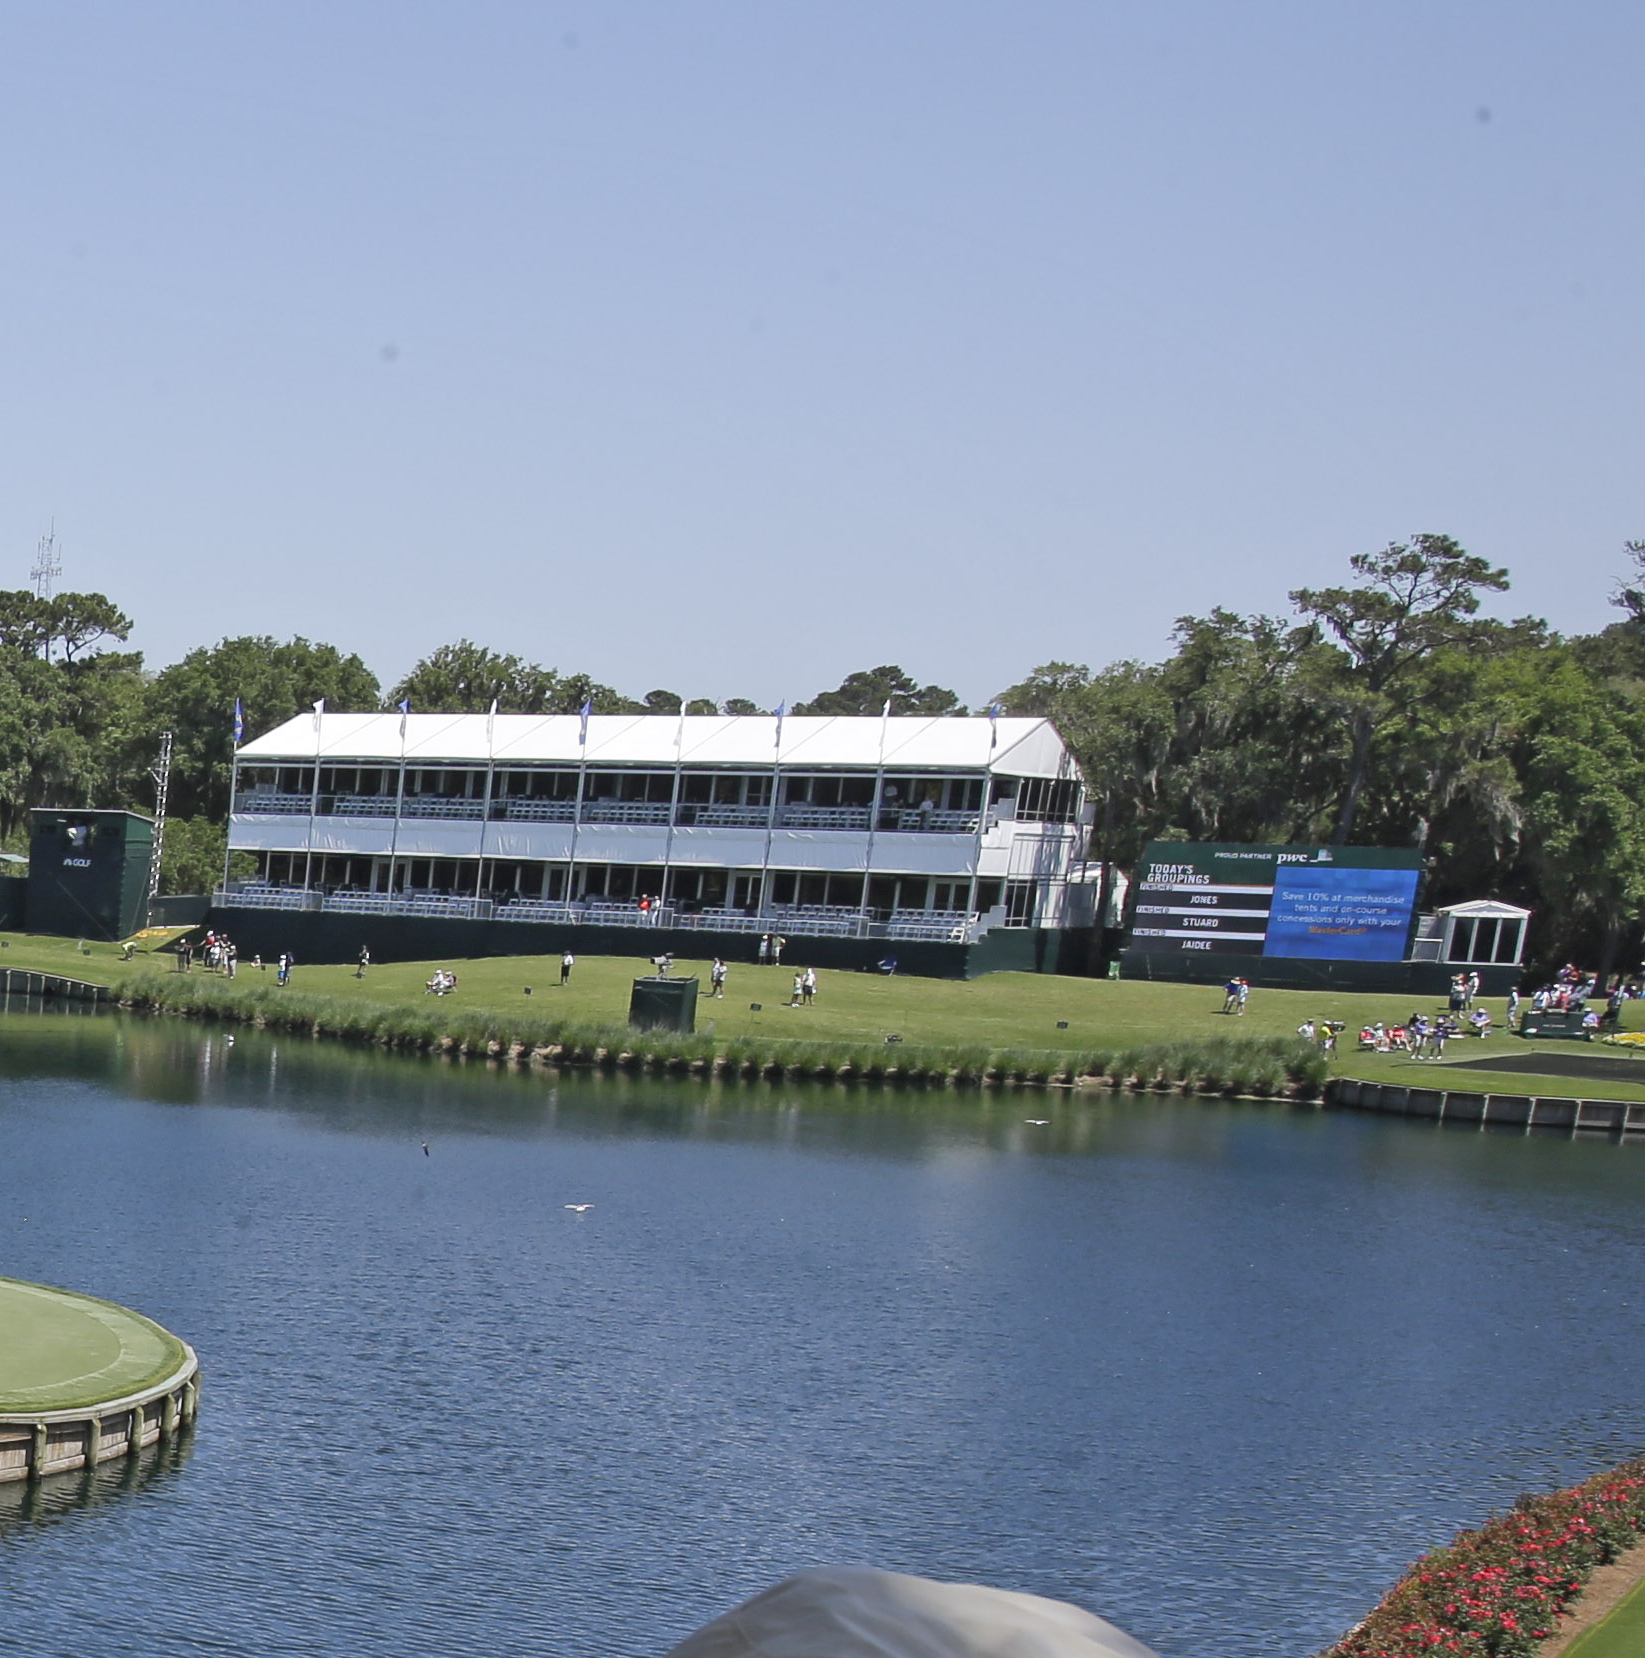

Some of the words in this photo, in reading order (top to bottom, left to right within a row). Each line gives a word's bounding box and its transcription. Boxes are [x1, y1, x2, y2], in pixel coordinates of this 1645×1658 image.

[1276, 853, 1308, 865] pwc
[1149, 863, 1194, 874] TODAY'S
[1147, 873, 1210, 884] GROUPINGS
[1190, 895, 1218, 905] JONES
[1282, 891, 1304, 901] Save
[1308, 892, 1329, 902] 10%
[1331, 893, 1342, 902] at
[1343, 894, 1405, 904] merchandise
[1294, 903, 1318, 912] tents
[1320, 904, 1338, 913] and
[1340, 904, 1388, 915] on-course
[1182, 917, 1219, 928] STUARD
[1277, 914, 1333, 924] concessions
[1335, 915, 1355, 926] only
[1358, 916, 1378, 925] with
[1380, 918, 1402, 928] your
